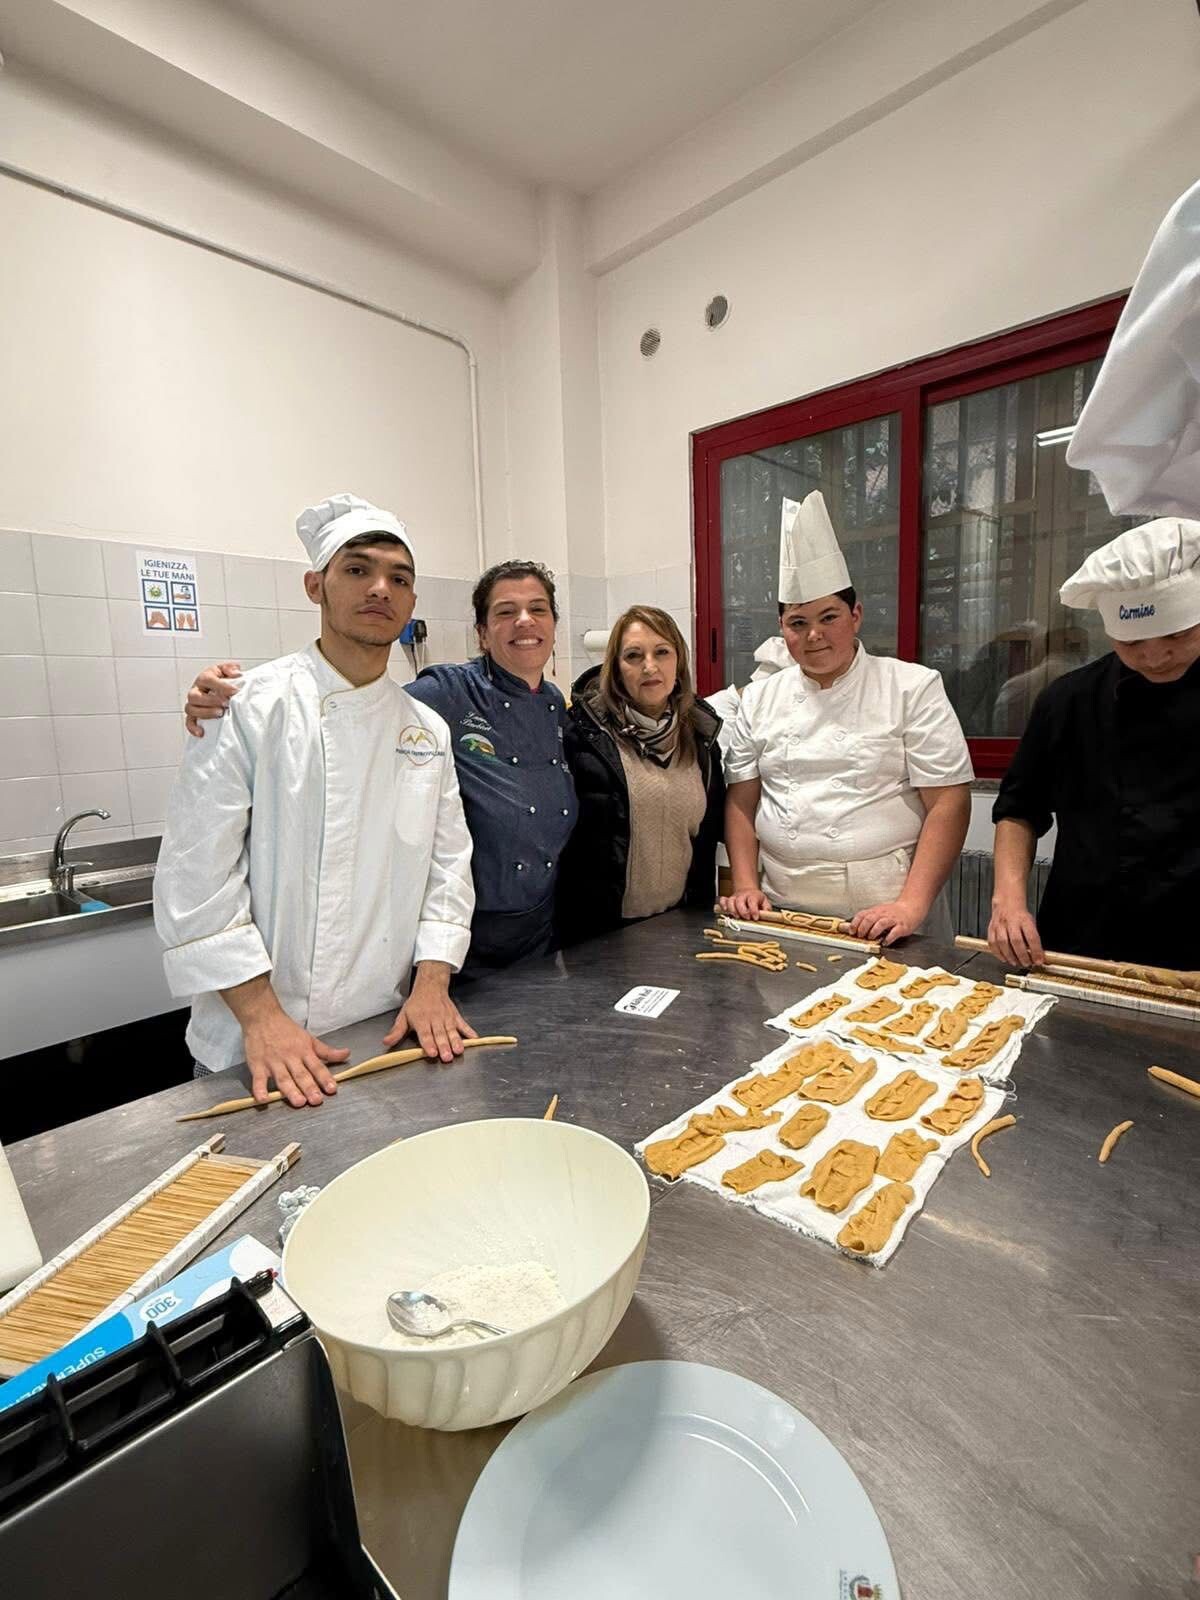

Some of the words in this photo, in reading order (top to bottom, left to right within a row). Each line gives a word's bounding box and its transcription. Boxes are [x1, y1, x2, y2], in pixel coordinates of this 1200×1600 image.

[144, 559, 188, 570] IGIENIZZA
[141, 569, 151, 577] LE
[153, 570, 170, 579] TUE
[172, 572, 195, 581] MANI
[1119, 603, 1155, 620] Carmine
[145, 1296, 177, 1319] 300
